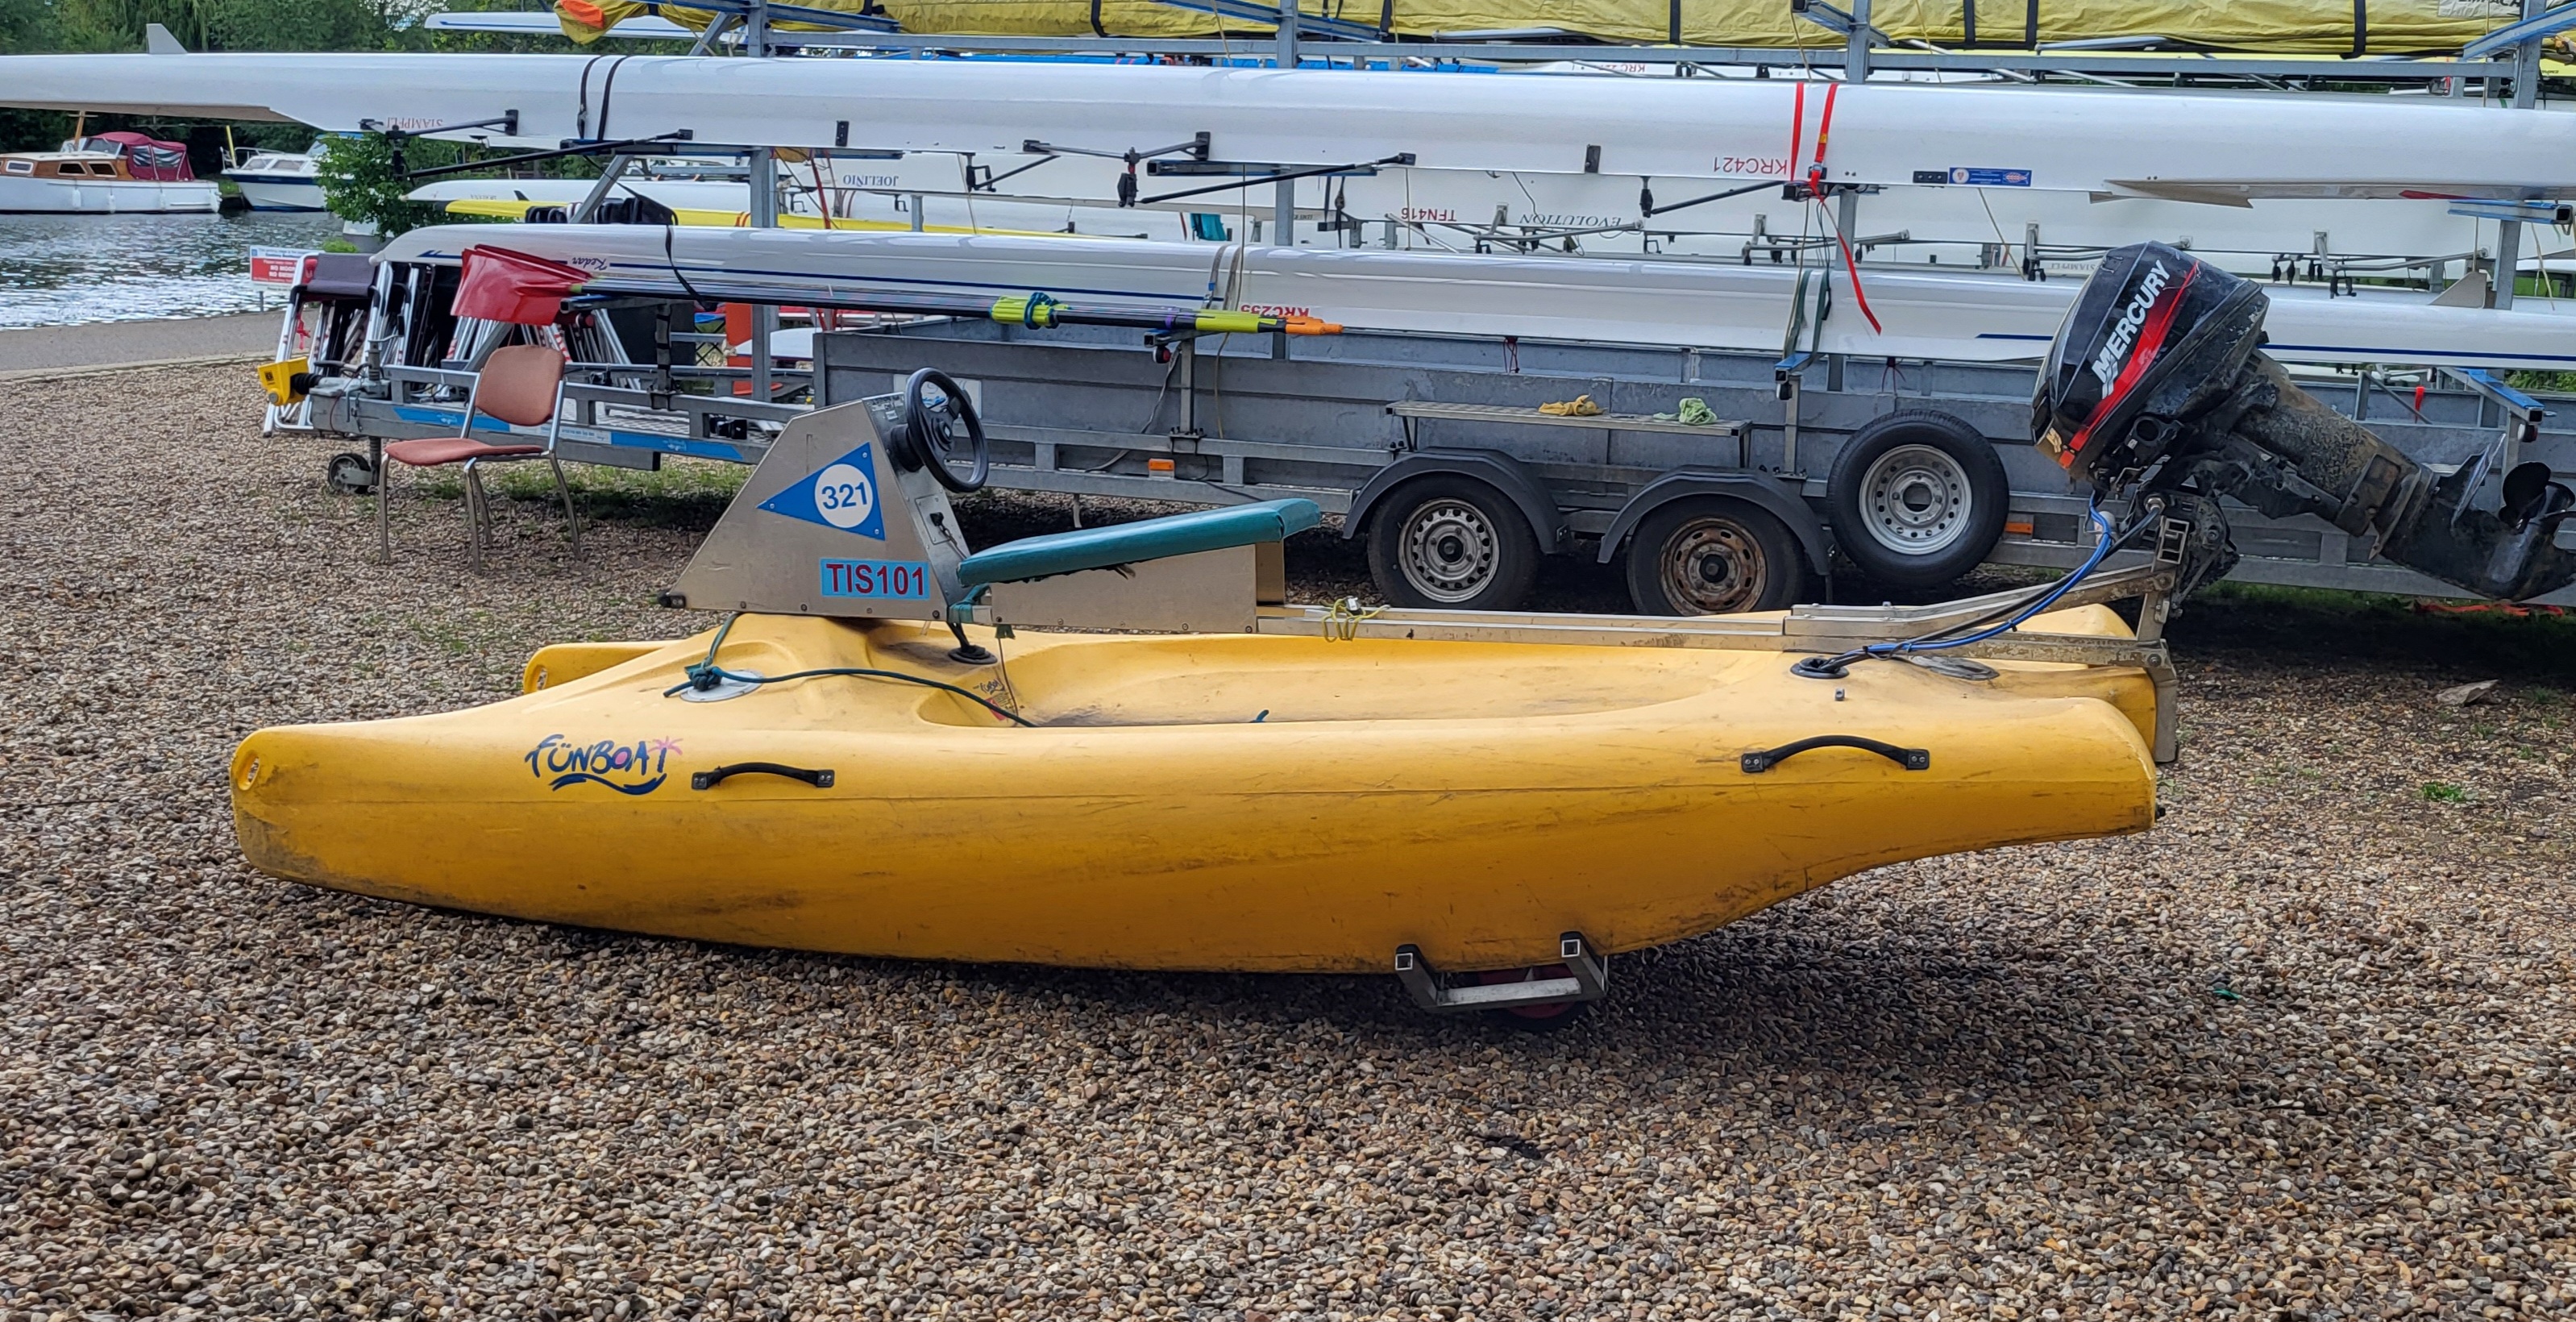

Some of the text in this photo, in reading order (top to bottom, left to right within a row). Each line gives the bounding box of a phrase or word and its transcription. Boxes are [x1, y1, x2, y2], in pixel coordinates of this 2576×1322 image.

[1714, 156, 1787, 175] KRC421
[1402, 207, 1457, 222] TFN416
[1519, 214, 1621, 227] EVOLUTION
[571, 257, 607, 271] Kedar
[2092, 260, 2171, 399] MERCURY
[821, 482, 867, 509] 321
[826, 563, 923, 596] TIS101
